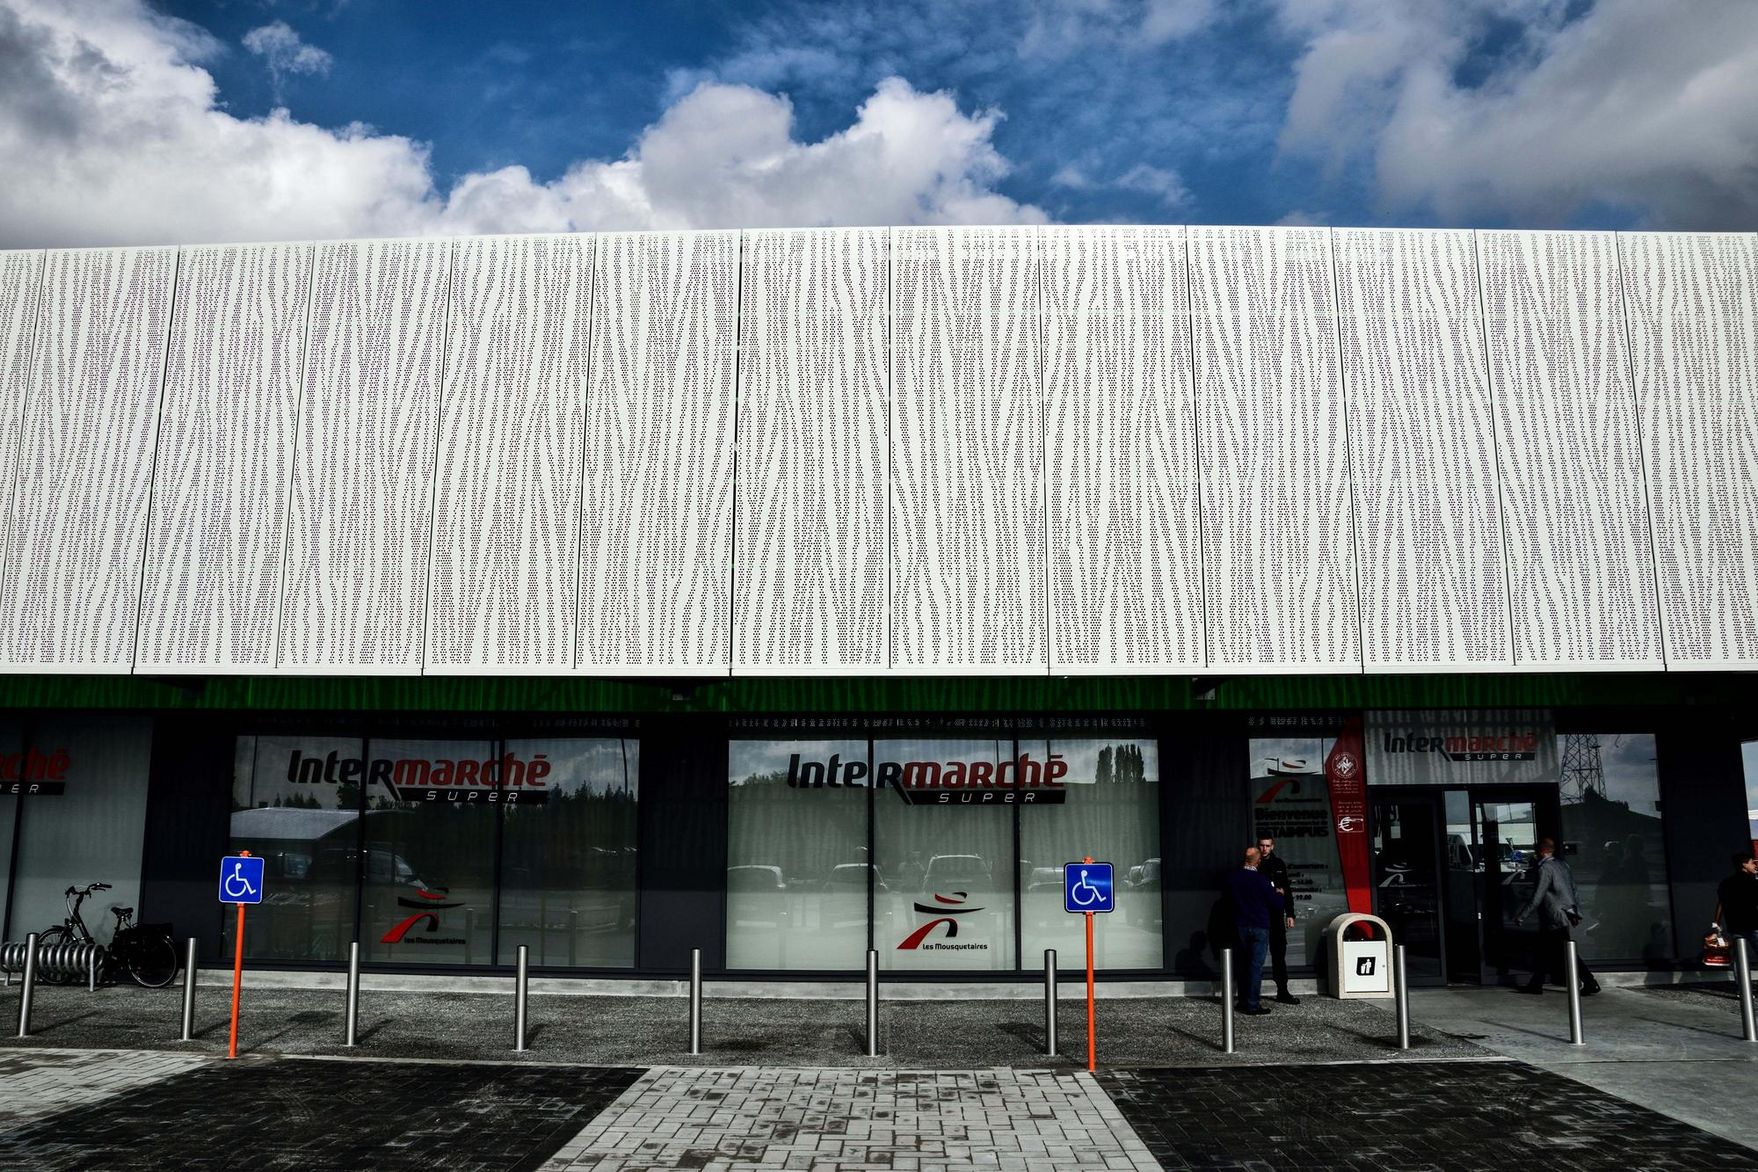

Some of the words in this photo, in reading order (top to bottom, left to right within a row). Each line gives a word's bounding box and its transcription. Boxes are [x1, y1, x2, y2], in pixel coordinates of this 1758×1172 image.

[0, 784, 40, 793] ER
[426, 790, 518, 802] SUPER
[938, 792, 1036, 803] SUPER
[935, 943, 988, 951] Mousquetaires
